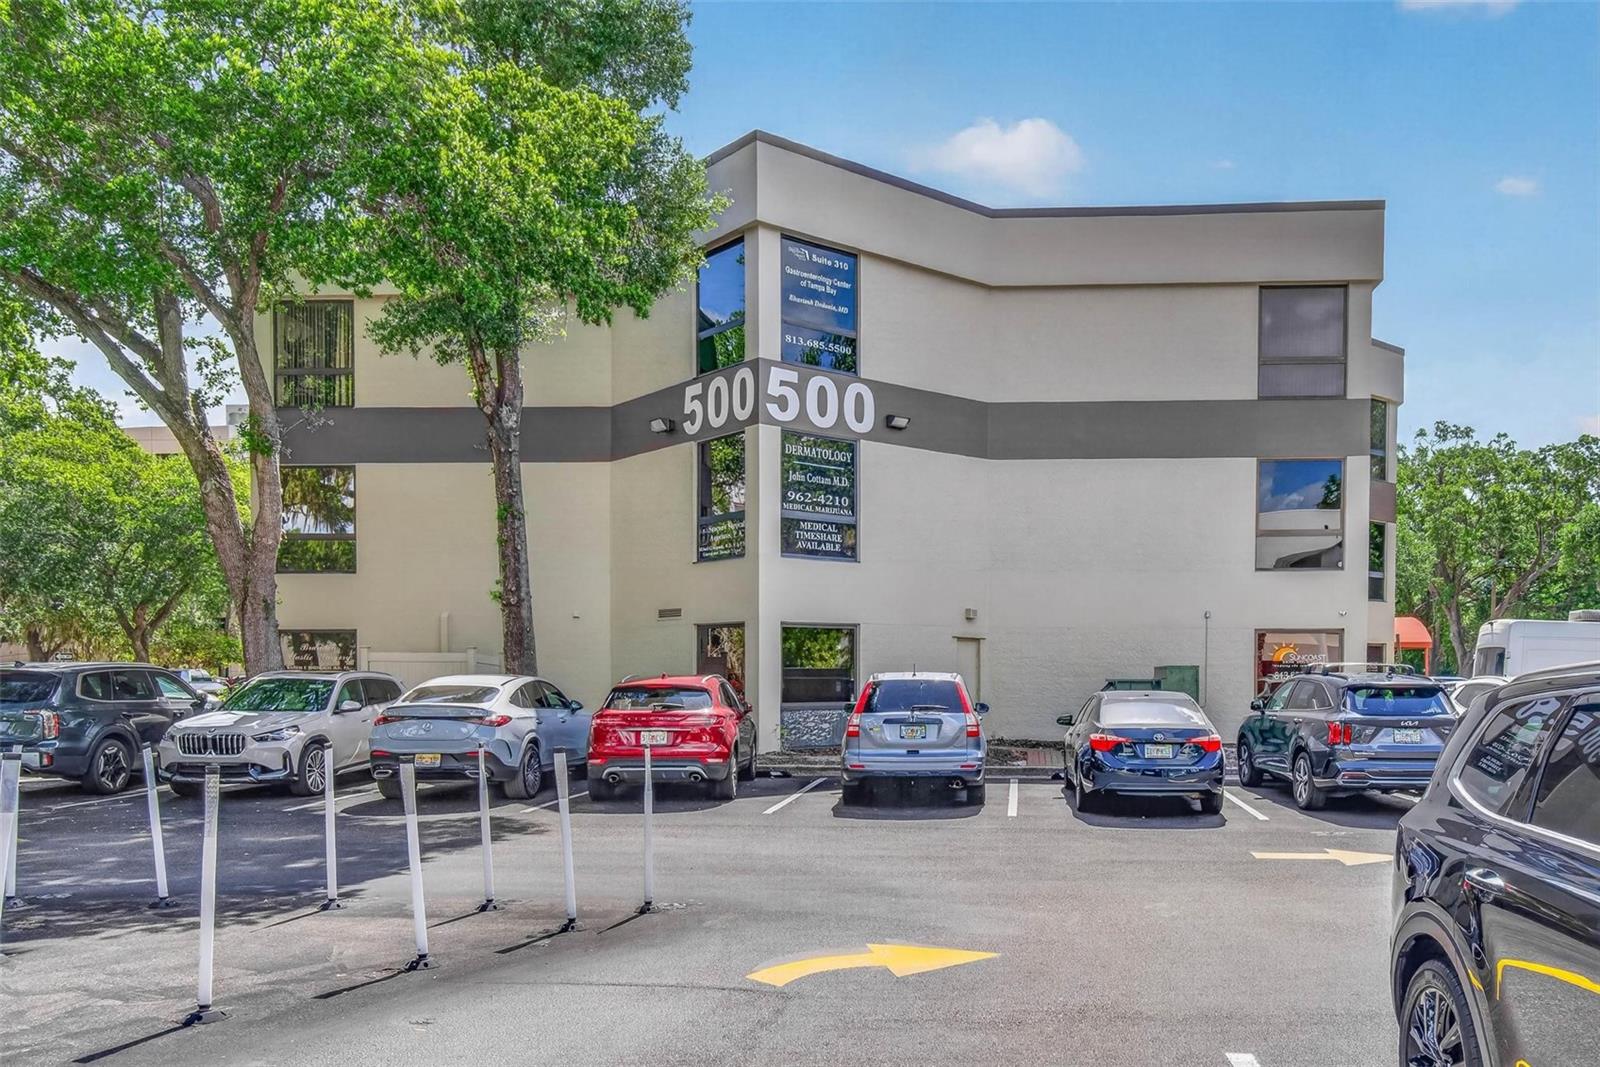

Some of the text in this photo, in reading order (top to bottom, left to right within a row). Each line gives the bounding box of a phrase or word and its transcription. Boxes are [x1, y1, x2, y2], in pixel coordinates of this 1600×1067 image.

[812, 254, 849, 271] Suite 310
[785, 265, 852, 290] Gastroenterology Center
[800, 280, 837, 297] of Tampa Bay
[838, 304, 849, 314] MD
[785, 334, 852, 355] 813.685.5500
[682, 367, 755, 435] 500
[766, 366, 875, 433] 500
[785, 443, 852, 463] DERMATOLOGY
[788, 470, 805, 482] John
[806, 473, 832, 486] Cottam
[787, 490, 849, 507] 962-4210
[783, 502, 853, 516] MEDICAL MARIJUANA
[800, 521, 838, 533] MEDICAL
[795, 530, 843, 543] TIMESHARE
[796, 540, 842, 552] AVAILABLE
